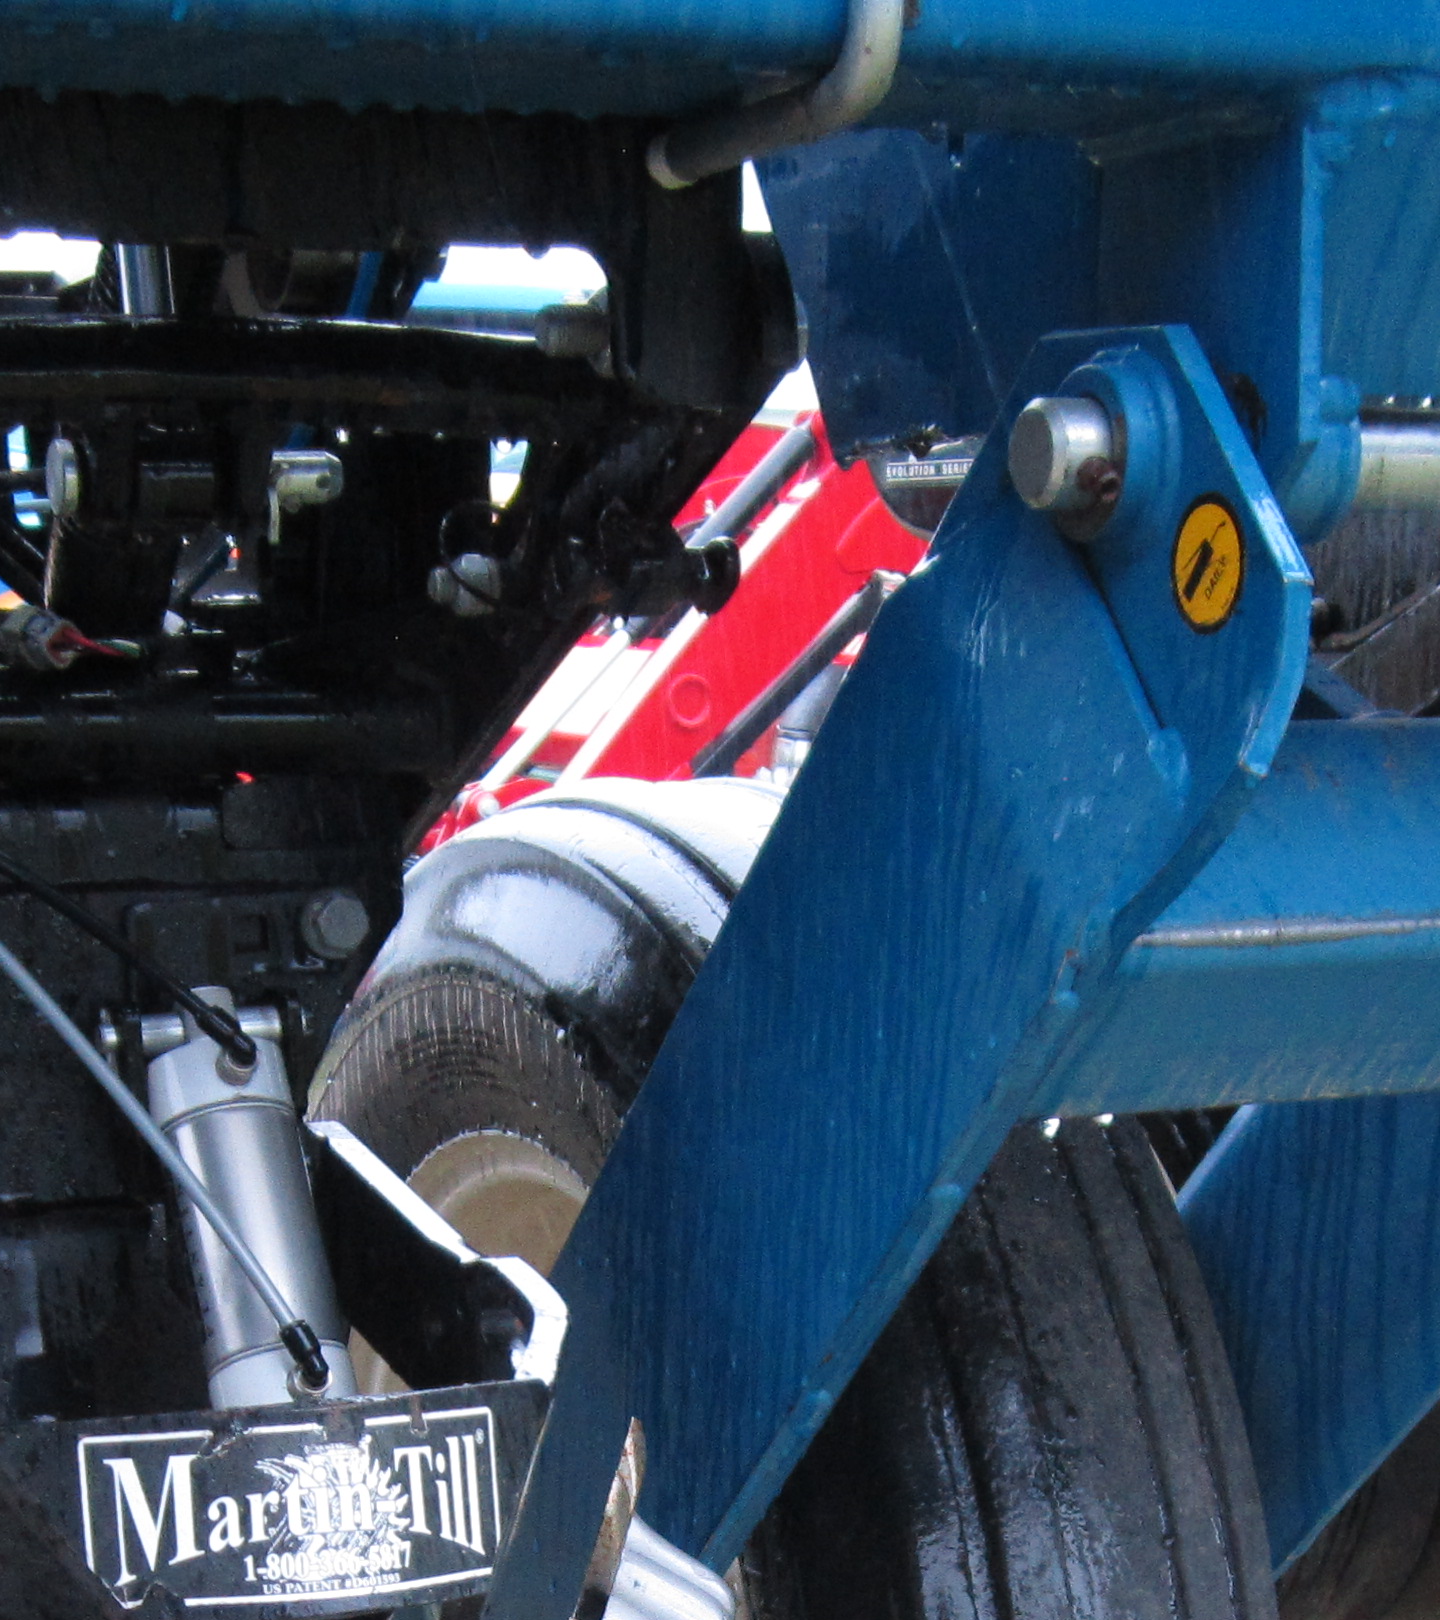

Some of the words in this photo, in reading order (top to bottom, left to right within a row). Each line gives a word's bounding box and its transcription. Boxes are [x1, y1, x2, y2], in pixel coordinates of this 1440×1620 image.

[885, 464, 936, 479] EVOLUTION
[102, 1434, 486, 1587] Martin-Till
[263, 1583, 283, 1595] US
[286, 1579, 342, 1593] PATENT
